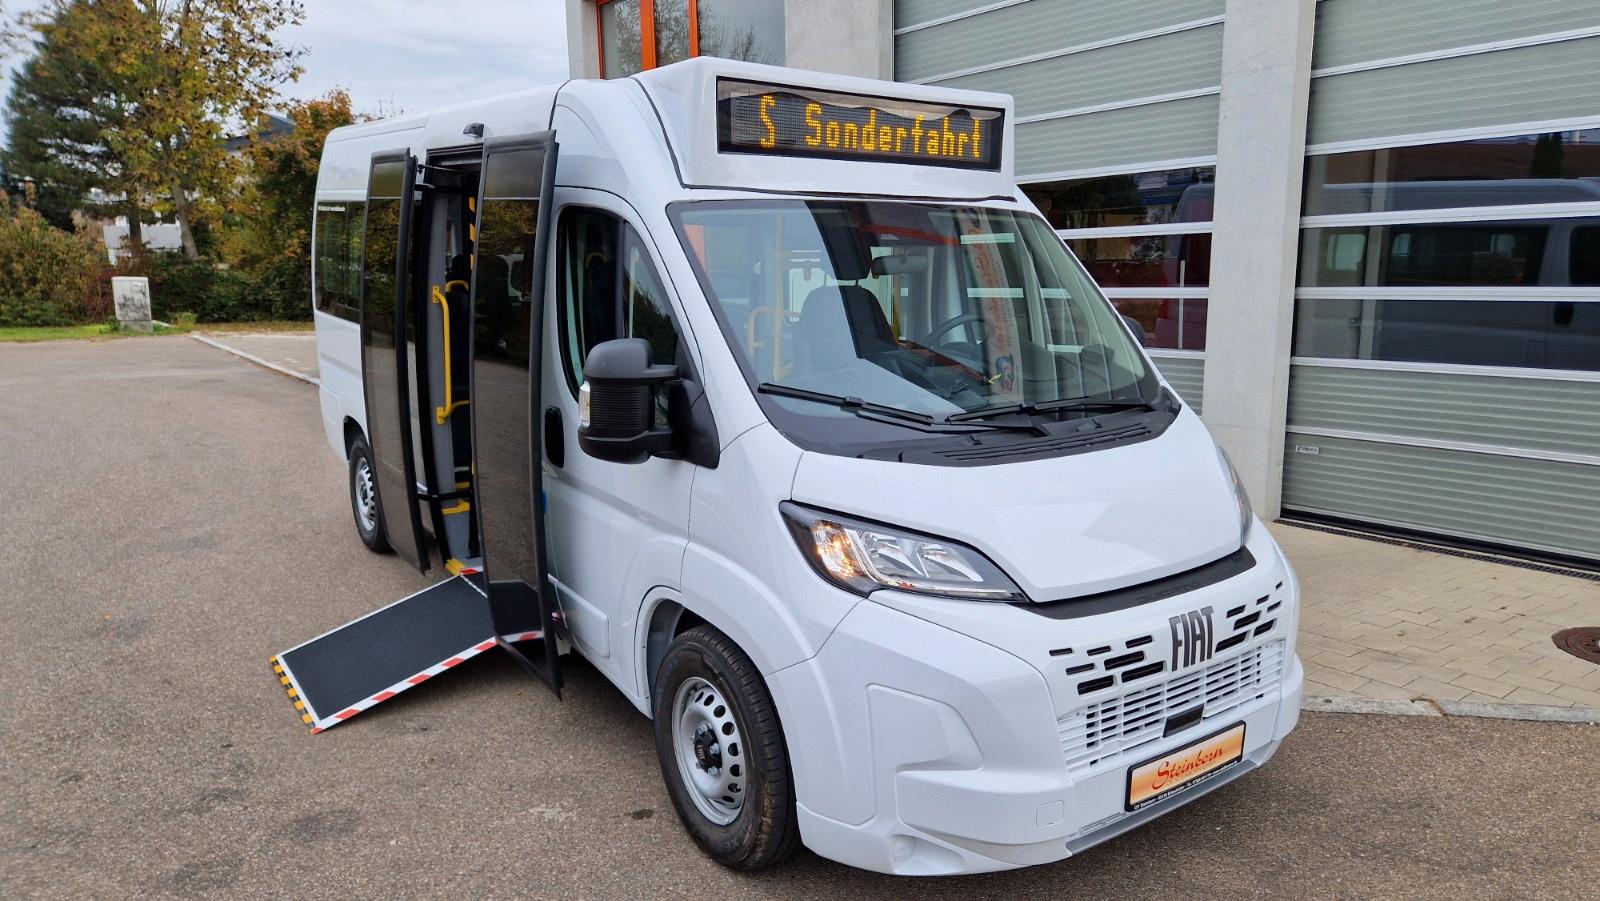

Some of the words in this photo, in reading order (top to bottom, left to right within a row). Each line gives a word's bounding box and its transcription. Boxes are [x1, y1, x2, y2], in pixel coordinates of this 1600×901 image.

[759, 95, 777, 148] S
[804, 102, 981, 159] Sonderfahrt
[1168, 605, 1214, 672] FIAT
